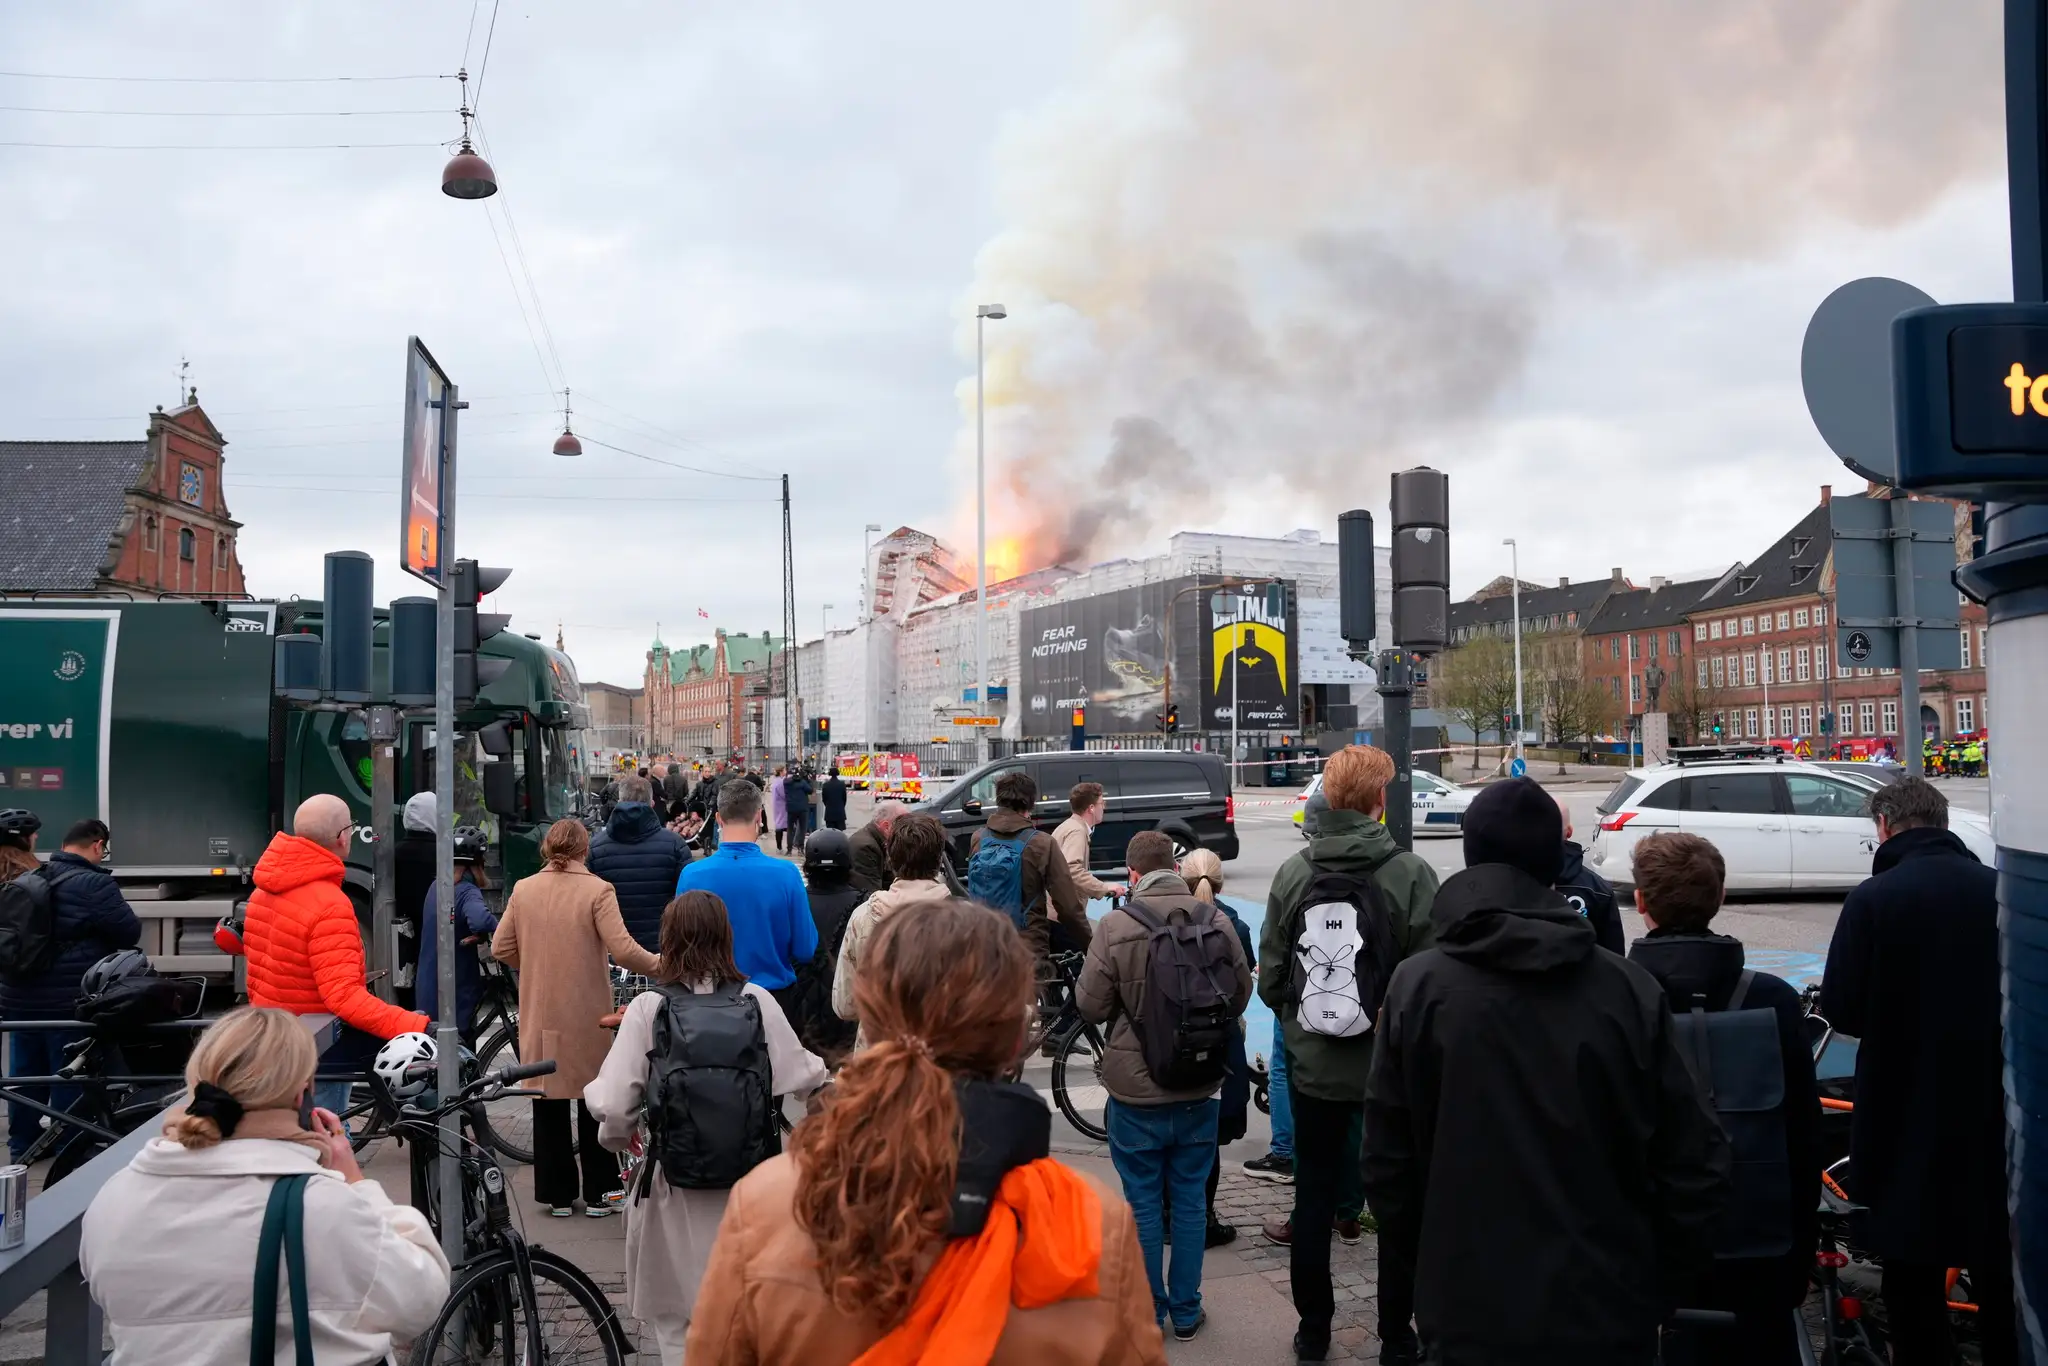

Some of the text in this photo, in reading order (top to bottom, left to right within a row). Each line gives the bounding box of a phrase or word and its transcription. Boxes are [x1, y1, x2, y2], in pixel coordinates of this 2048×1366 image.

[225, 624, 264, 632] NTM
[1042, 625, 1076, 641] FEAR
[1031, 638, 1088, 658] NOTHING
[48, 718, 73, 739] vi
[1326, 920, 1342, 930] HH
[1322, 1010, 1339, 1019] 33L
